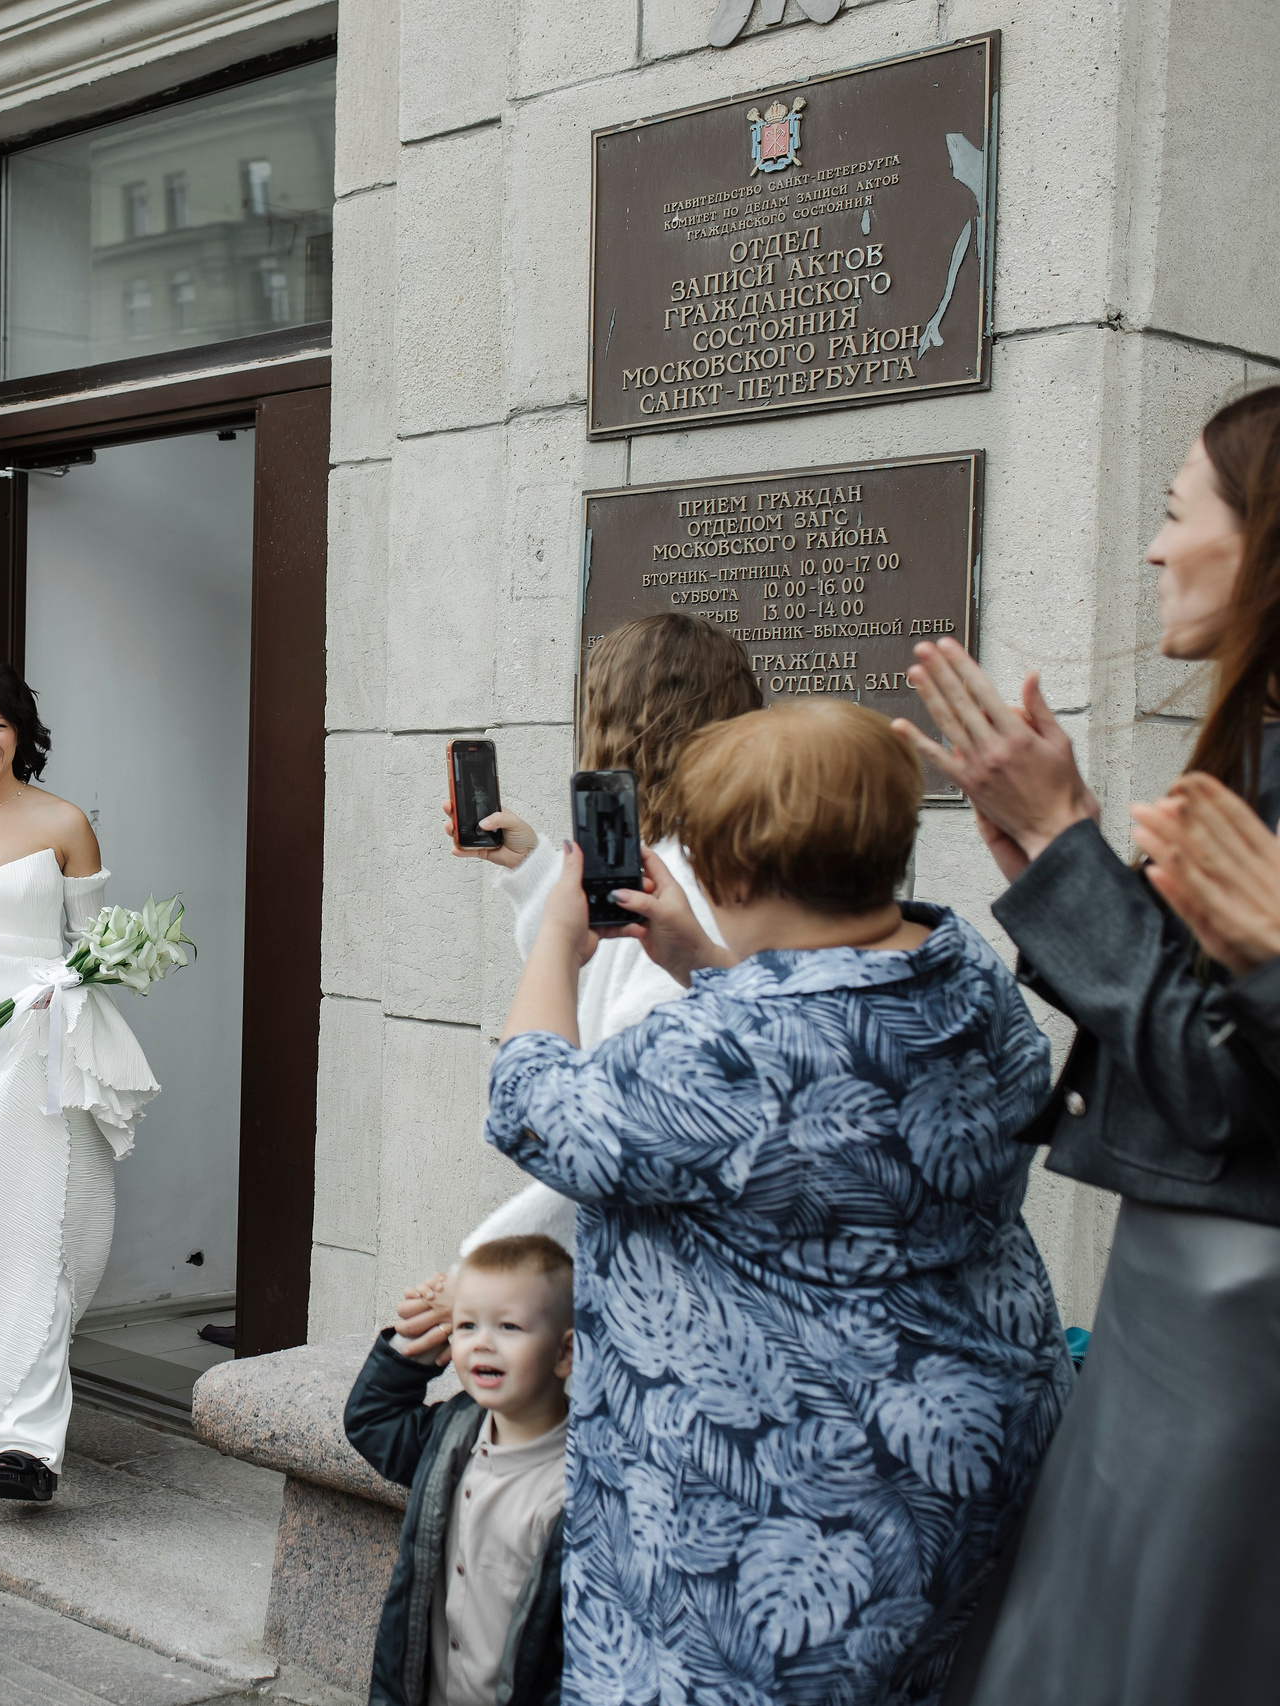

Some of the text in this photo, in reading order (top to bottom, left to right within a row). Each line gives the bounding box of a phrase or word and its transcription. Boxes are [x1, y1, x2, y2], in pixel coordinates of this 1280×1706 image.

[663, 154, 901, 214] ПРАВИТЕЛЬСТВО САНКТ-ПЕТЕРБУРГА
[664, 173, 900, 231] КОМИТЕТ ПО ДЕЛАМ ЗАПИСИ АКТОВ
[687, 195, 874, 241] ГРАЖДАНСКОГО СОСТОЯНИЯ
[730, 227, 821, 263] ОТДЕЛ
[671, 243, 884, 302] ЗАПИСИ АКТОВ
[664, 272, 891, 330] ГРАЖДАНСКОГО
[692, 306, 858, 351] СОСТОЯНИЯ
[622, 341, 816, 391] МОСКОВСКОГО
[640, 356, 917, 414] САНКТ-ПЕТЕРБУРГА
[678, 484, 862, 518] ПРИЕМ ГРАЖДАН
[687, 508, 849, 538] ОТДЕЛОМ ЗАГС
[652, 526, 889, 561] МОСКОВСКОГО РАЙОНА
[642, 564, 792, 587] ВТОРНИК-ПЯТНИЦА
[671, 588, 739, 604] СУББОТА
[726, 618, 955, 642] ДЕЛЬНИК-ВЫХОДНОЙ ДЕНЬ
[751, 651, 858, 672] ГРАЖДАН
[770, 674, 856, 695] ОТДЕЛА
